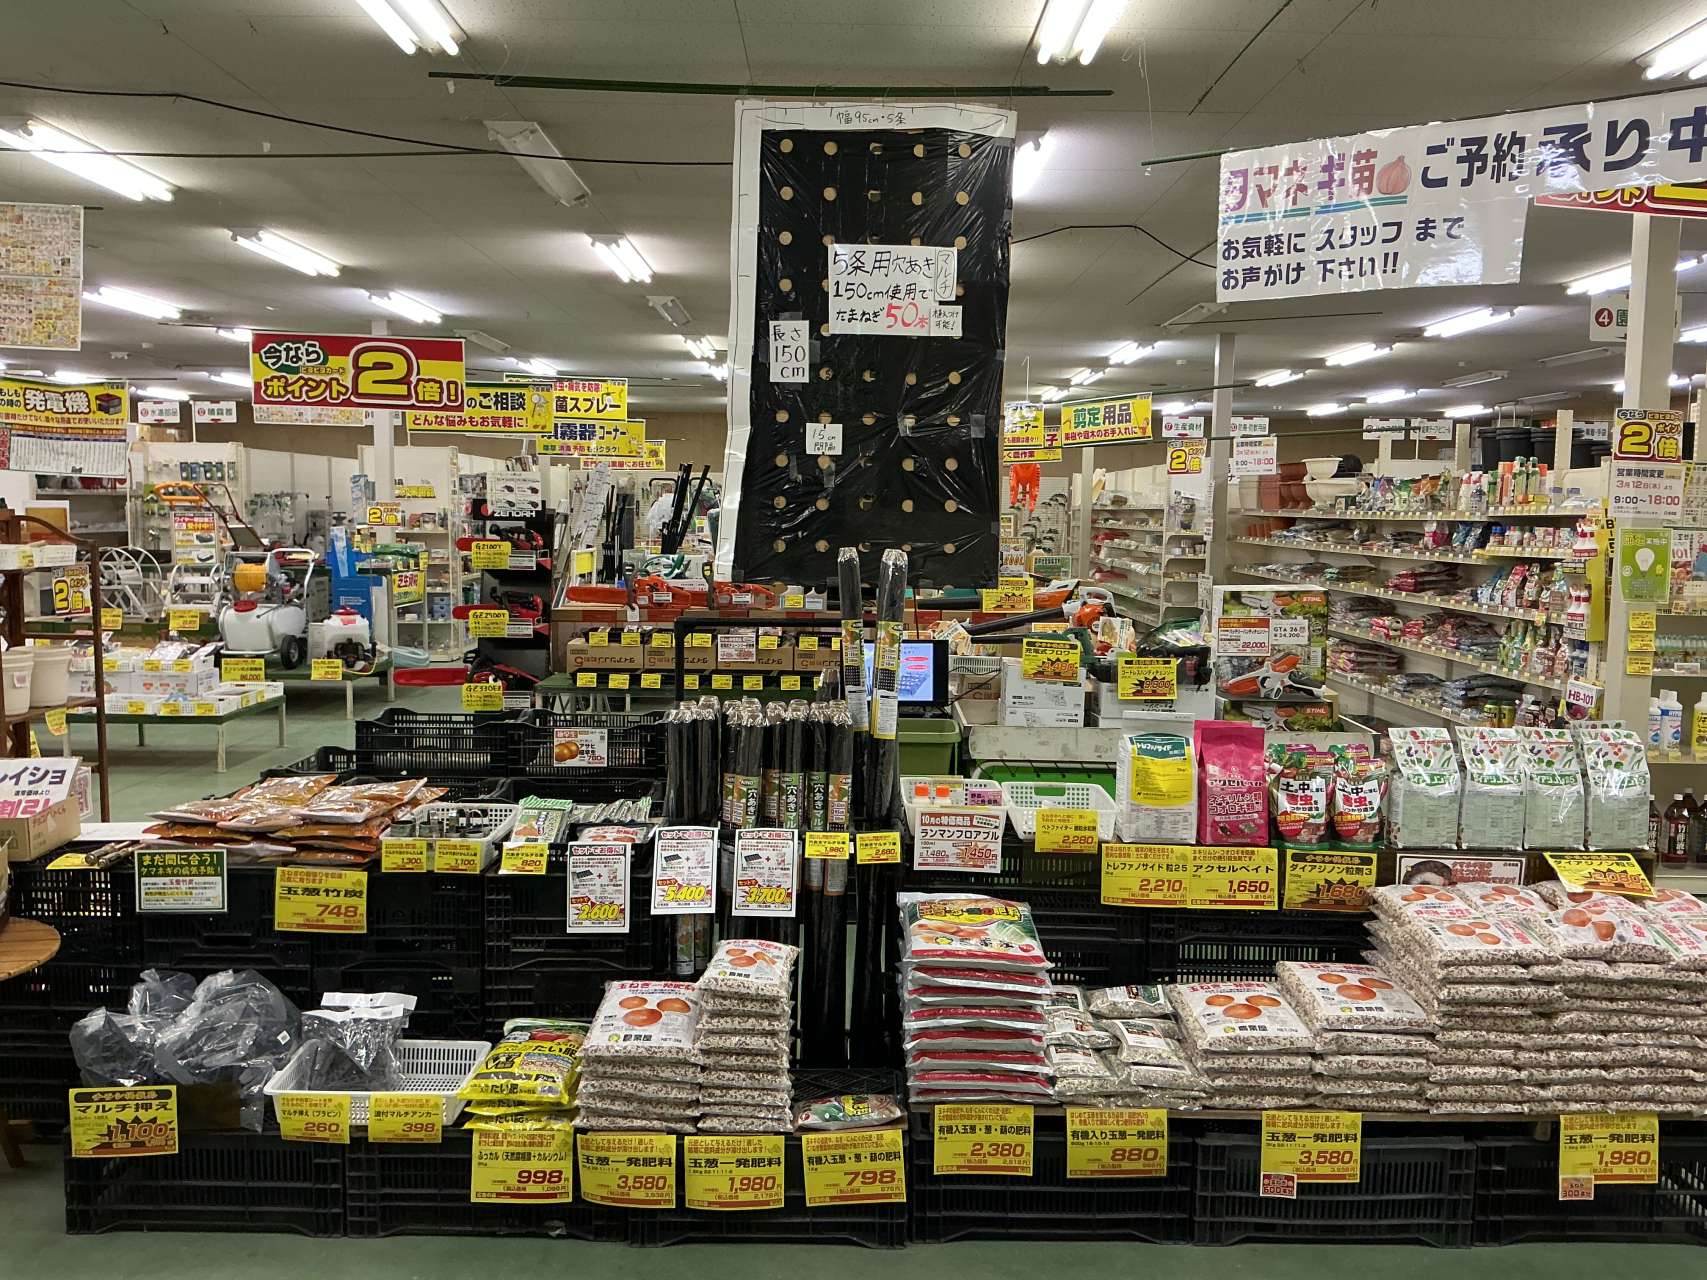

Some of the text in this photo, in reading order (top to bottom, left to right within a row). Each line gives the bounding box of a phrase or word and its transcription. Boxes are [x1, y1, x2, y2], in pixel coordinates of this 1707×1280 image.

[1221, 264, 1305, 291] お声がけ
[263, 343, 321, 367] 今なら
[774, 345, 807, 363] 150
[25, 388, 90, 414] 発電機
